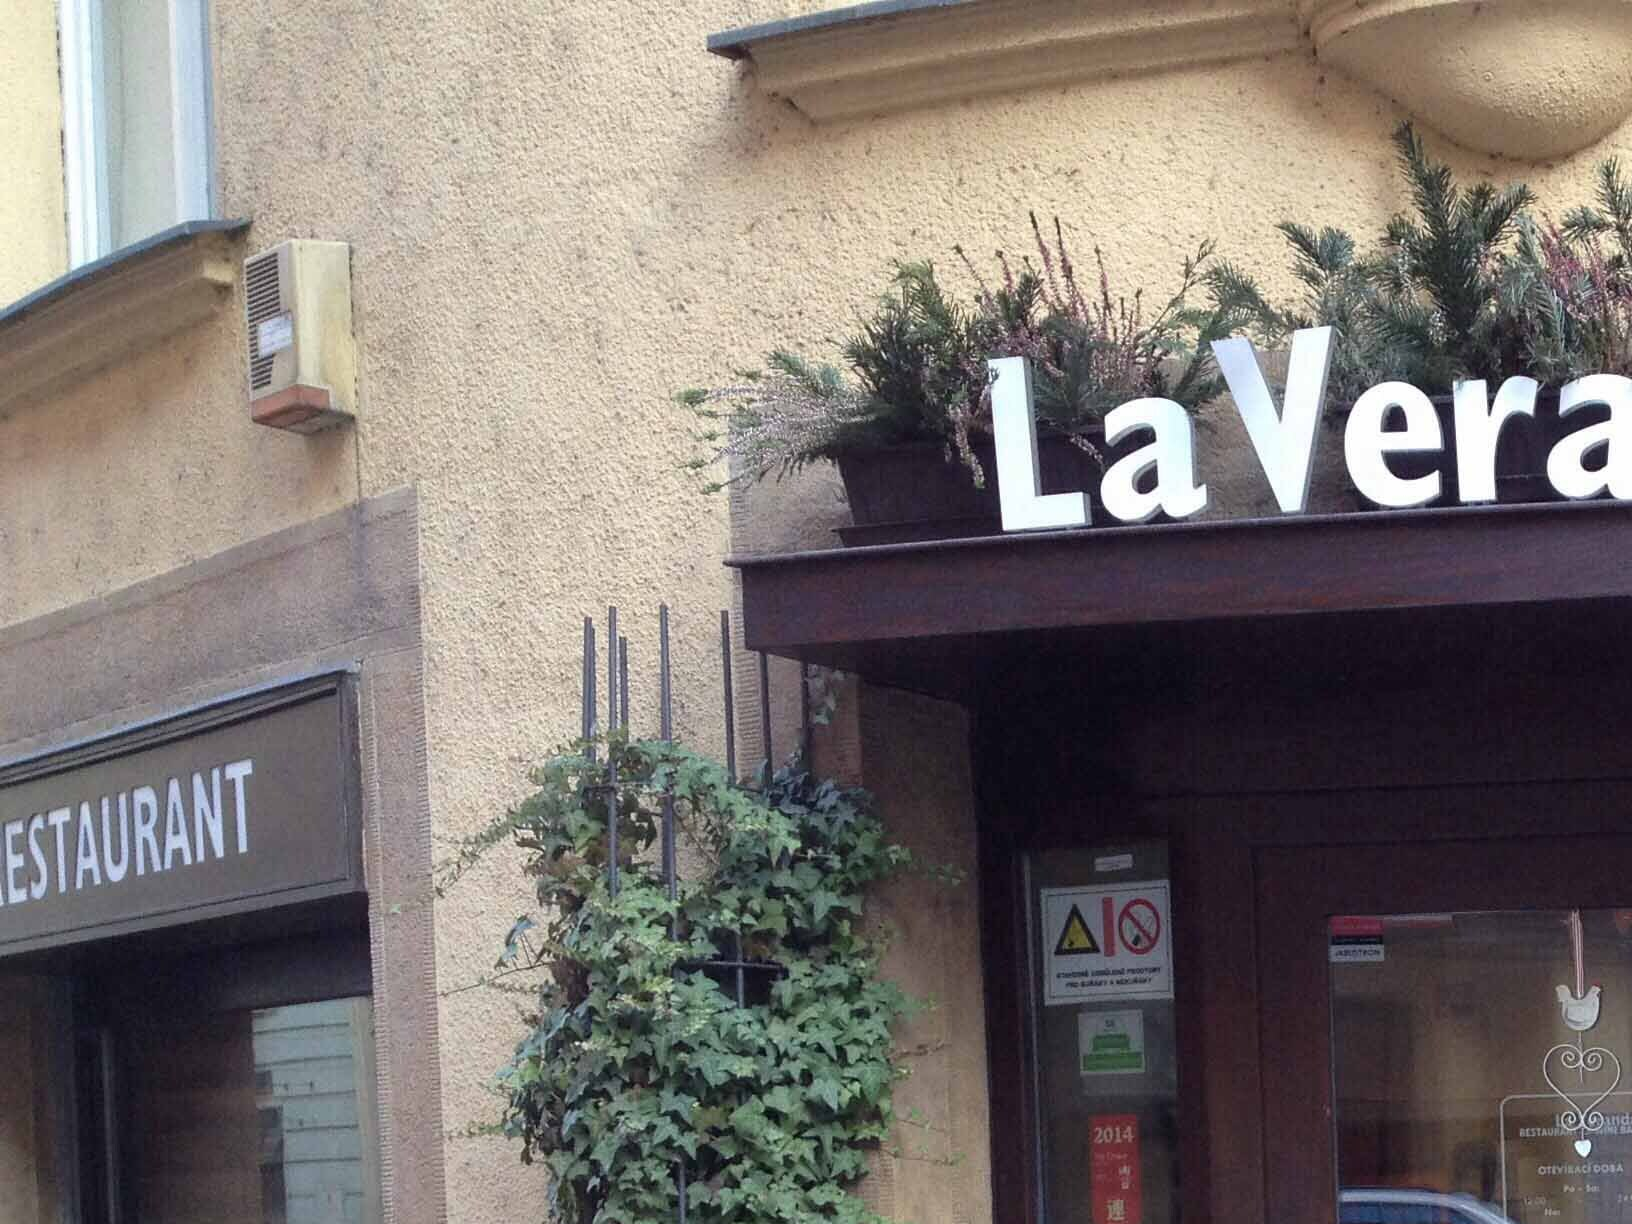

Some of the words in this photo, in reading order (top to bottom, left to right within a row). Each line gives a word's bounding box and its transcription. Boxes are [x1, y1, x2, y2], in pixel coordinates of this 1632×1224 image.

[988, 357, 1207, 531] La
[0, 759, 253, 906] ESTAURANT
[1093, 1126, 1135, 1144] 2014
